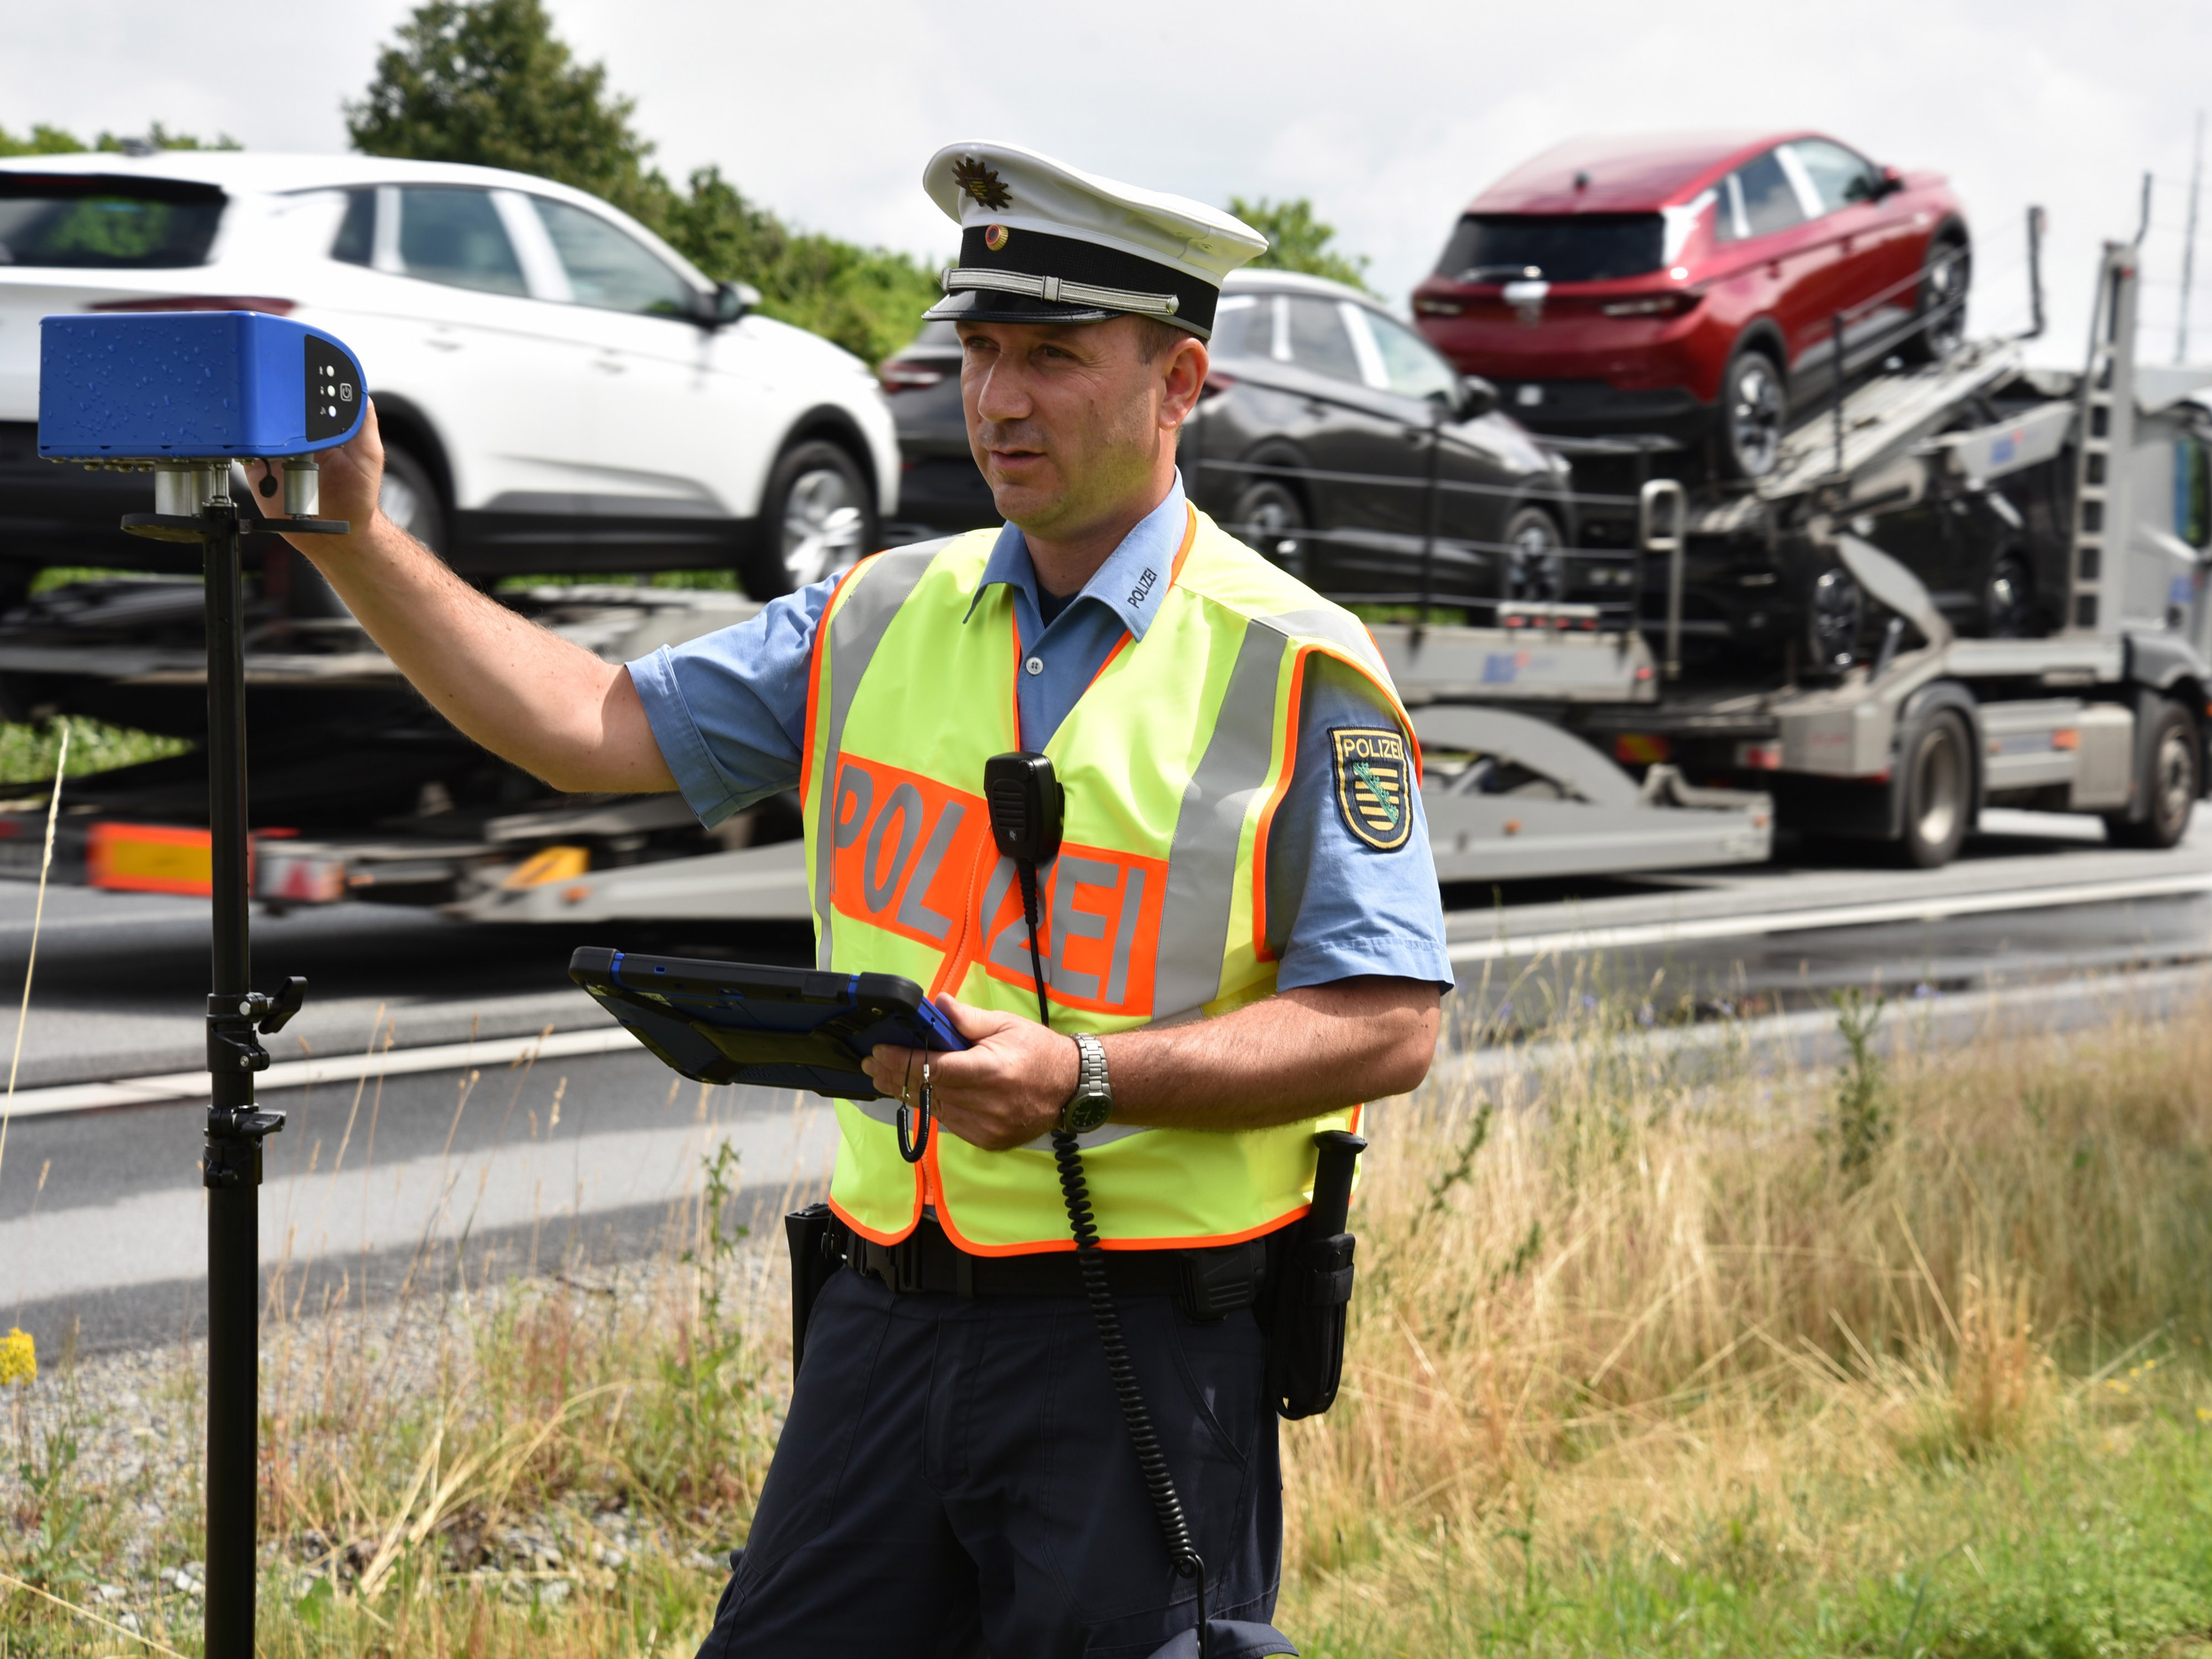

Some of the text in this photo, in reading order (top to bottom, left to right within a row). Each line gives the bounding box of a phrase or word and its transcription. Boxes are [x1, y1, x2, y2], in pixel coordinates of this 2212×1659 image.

[1128, 568, 1157, 609] POLIZEI
[1343, 738, 1401, 759] POLIZEI
[831, 764, 1146, 1005] POLIZEI
